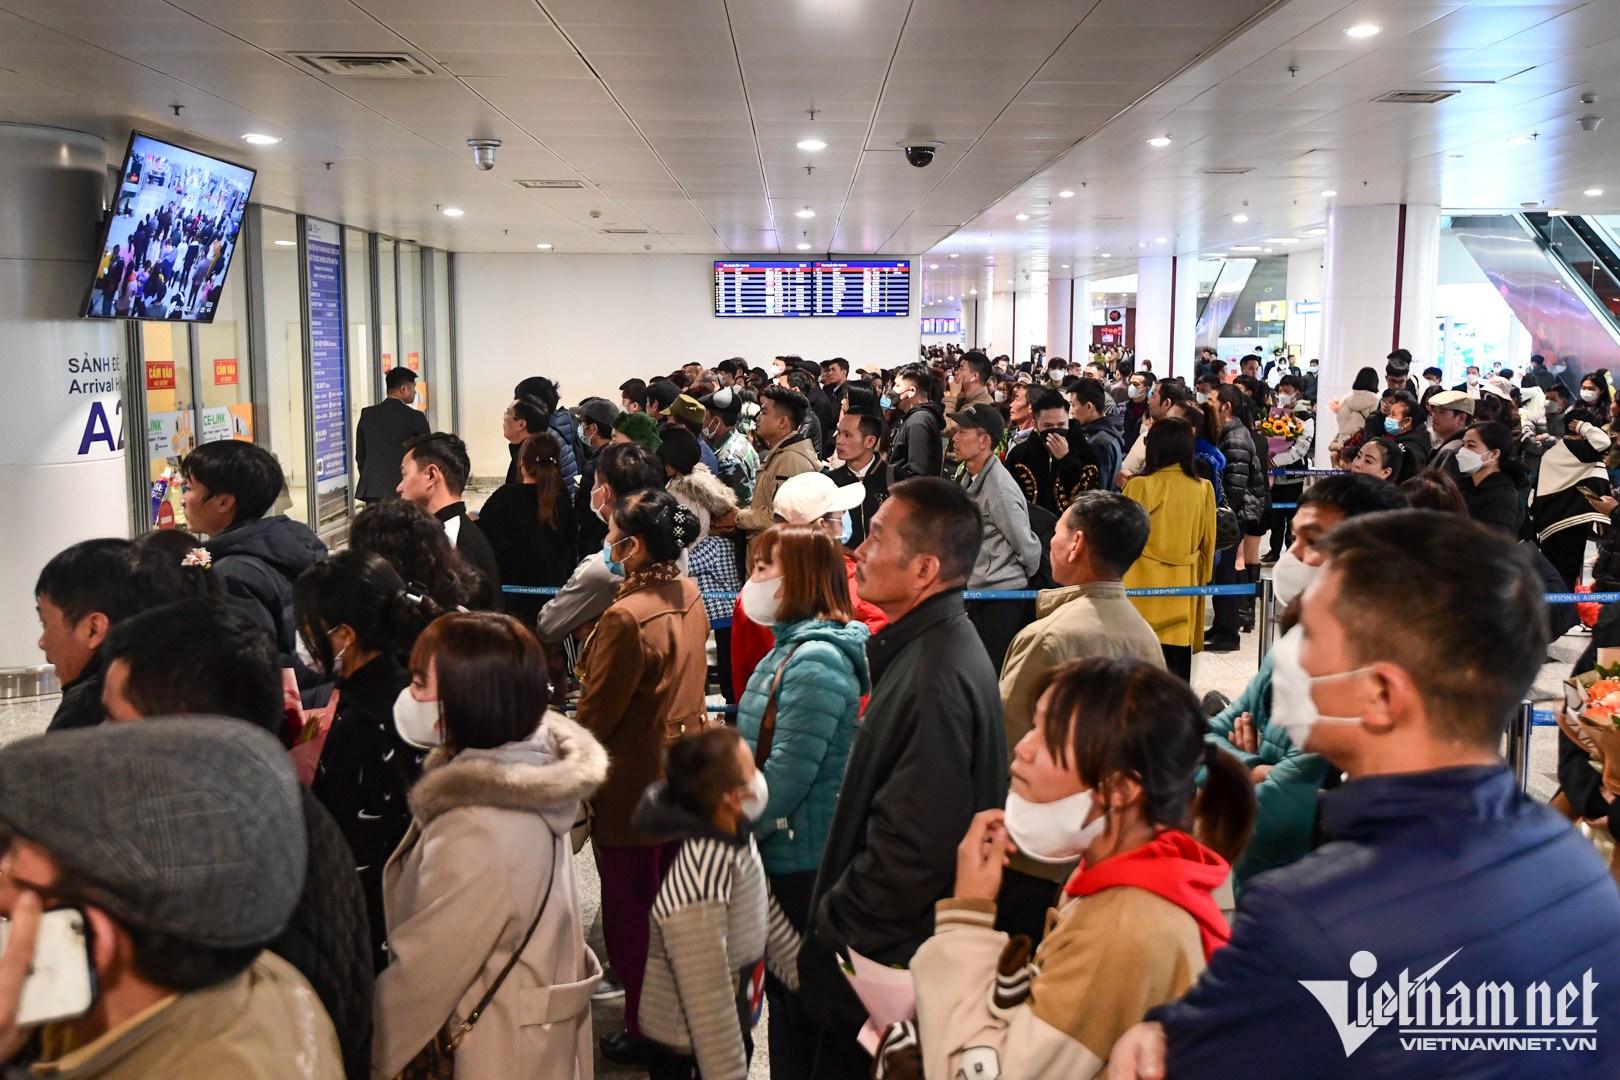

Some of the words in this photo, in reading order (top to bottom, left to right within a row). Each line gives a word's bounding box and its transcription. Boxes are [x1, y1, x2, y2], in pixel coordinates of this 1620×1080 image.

[68, 352, 110, 373] SẢNH
[227, 362, 236, 375] VÀO
[148, 364, 161, 378] CẤM
[162, 365, 172, 378] VÀO
[68, 378, 114, 394] Arrival
[203, 413, 225, 426] CE-LINK
[1147, 588, 1180, 596] AIRPORT
[1583, 593, 1618, 601] AIRPORT
